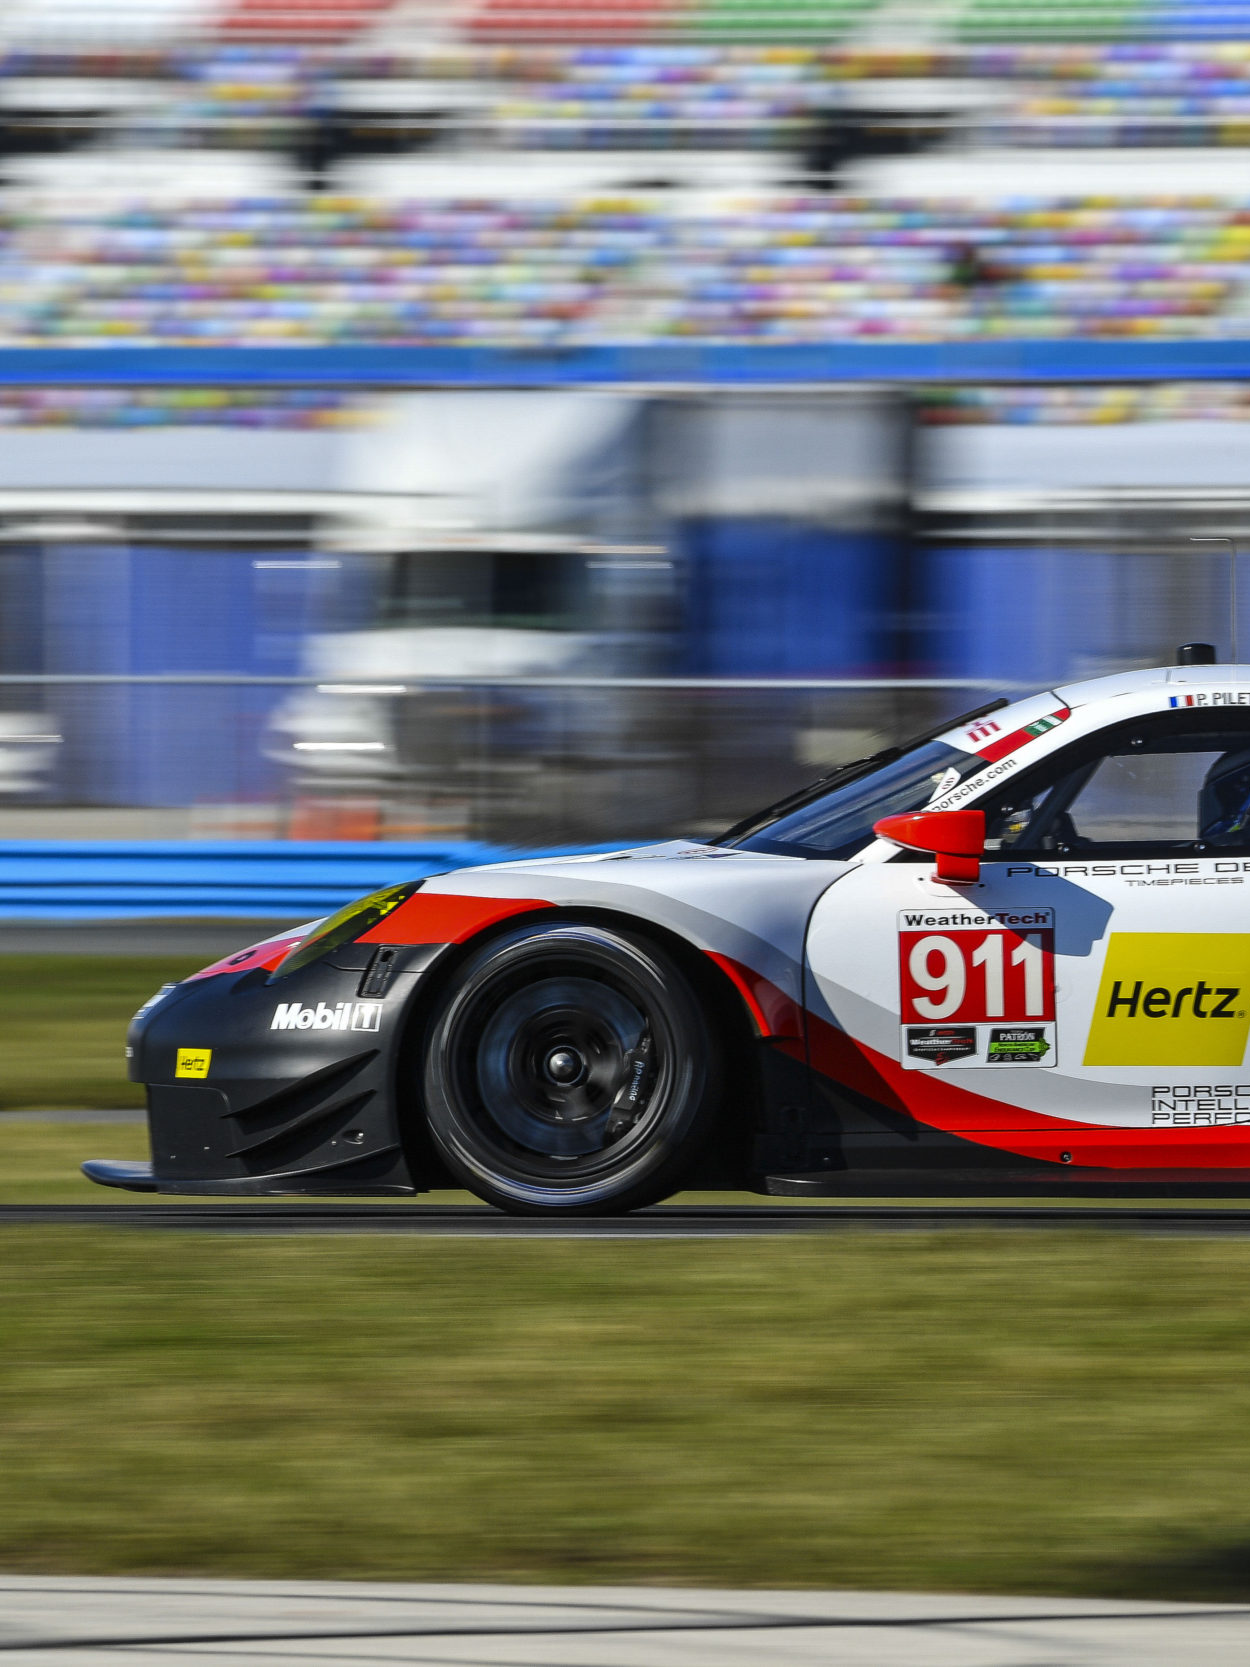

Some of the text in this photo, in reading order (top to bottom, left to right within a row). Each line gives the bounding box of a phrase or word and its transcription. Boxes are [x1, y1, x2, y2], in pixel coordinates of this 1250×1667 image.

[1197, 694, 1208, 706] P.
[1007, 863, 1199, 878] PORSCHE
[1125, 877, 1244, 888] TIMEPIECES
[904, 912, 1048, 927] WeatherTech
[908, 933, 1044, 1020] 911
[270, 1002, 351, 1030] Mobil
